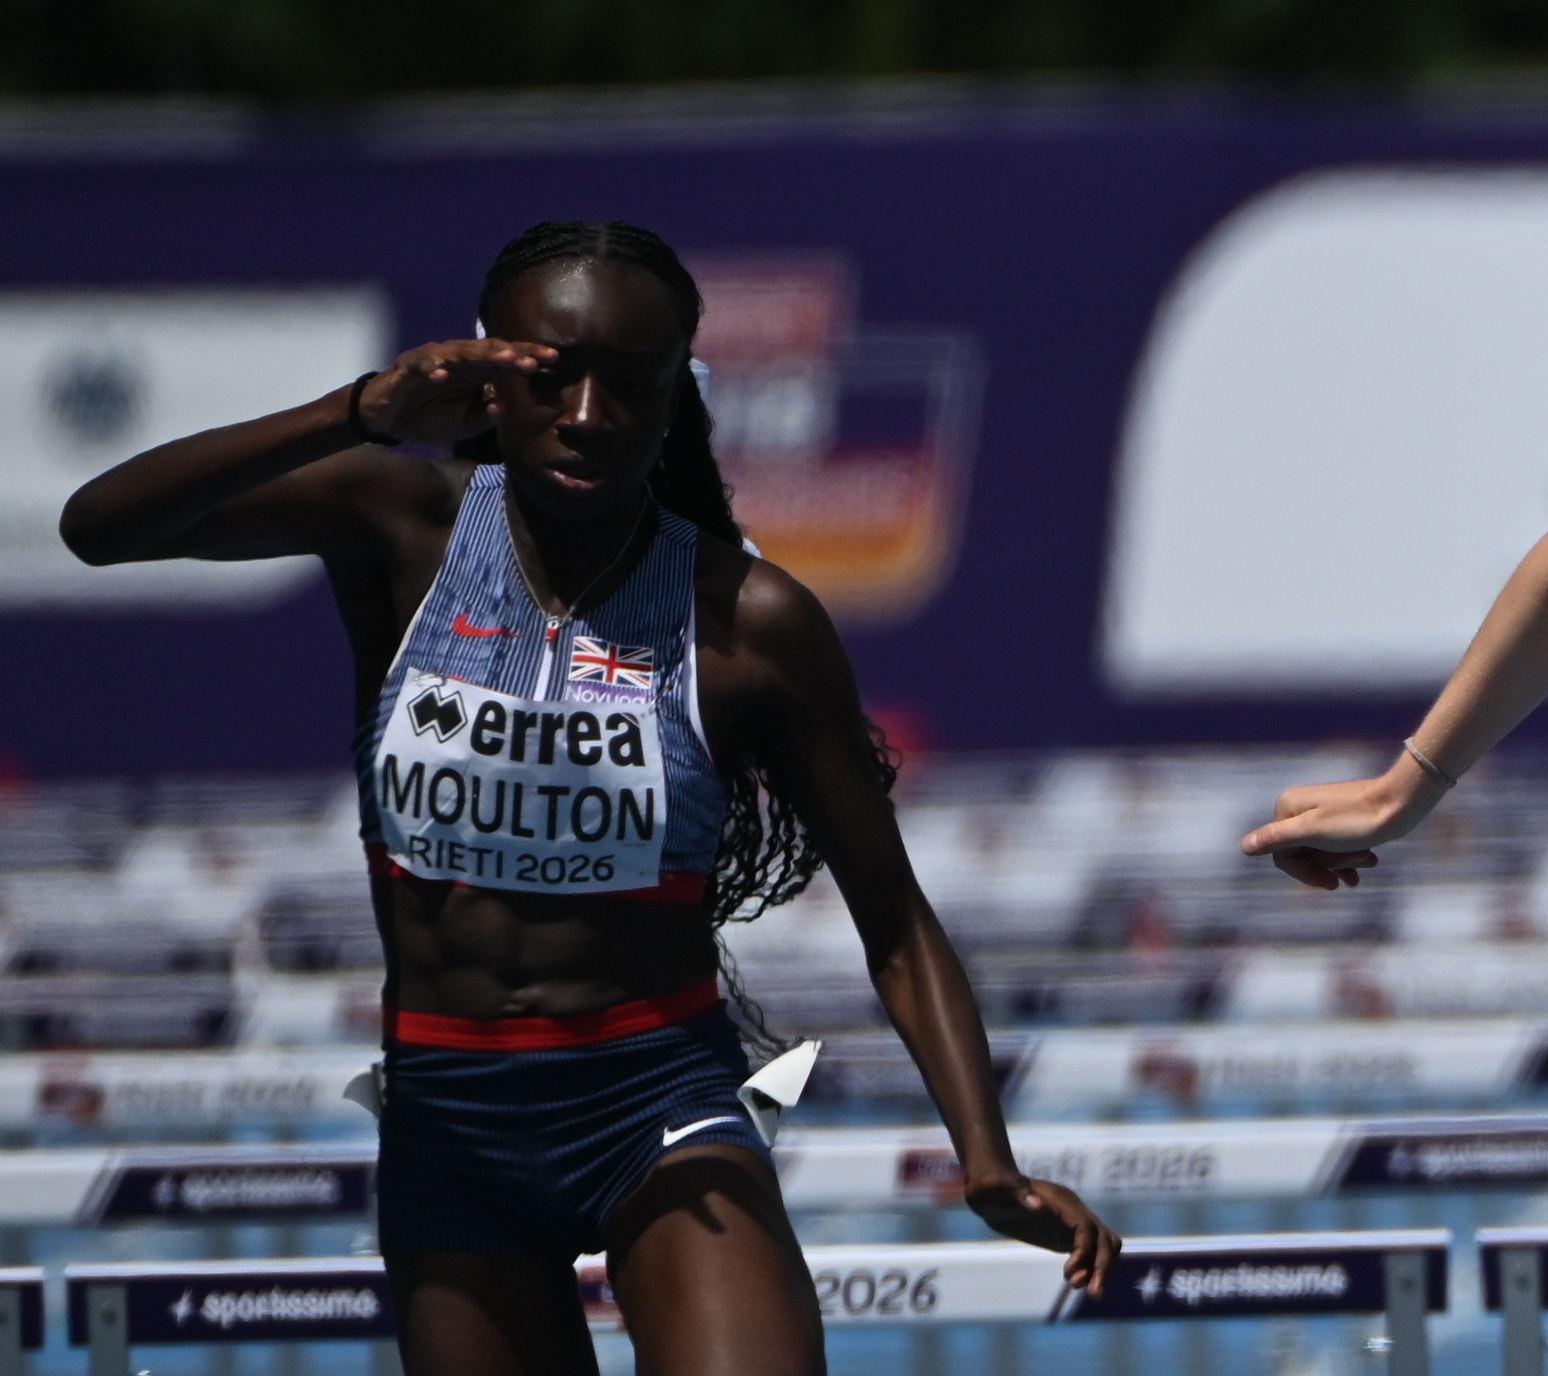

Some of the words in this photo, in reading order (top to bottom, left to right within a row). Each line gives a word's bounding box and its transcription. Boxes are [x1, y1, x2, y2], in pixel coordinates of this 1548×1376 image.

[382, 754, 654, 843] MOULTON
[409, 835, 504, 880] RIETI
[516, 853, 616, 884] 2026
[202, 1286, 380, 1328] sportissimo
[815, 1267, 940, 1316] 2026
